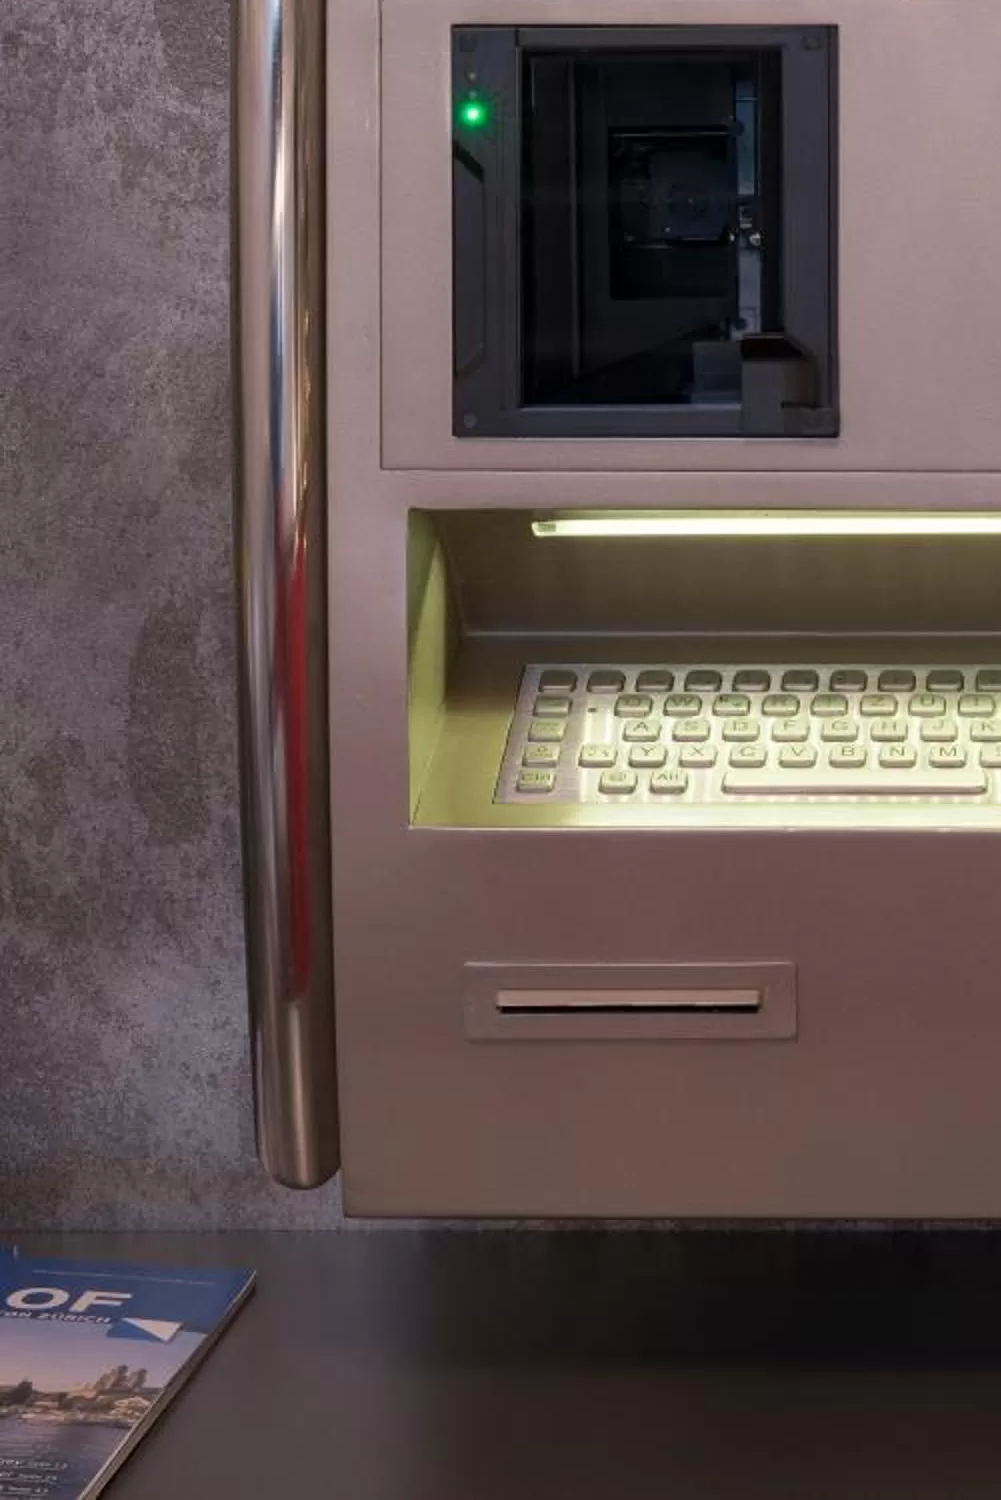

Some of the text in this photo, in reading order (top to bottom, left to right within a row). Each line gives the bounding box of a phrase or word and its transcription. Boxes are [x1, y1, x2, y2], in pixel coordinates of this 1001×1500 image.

[633, 721, 649, 731] A
[684, 721, 699, 732] S
[782, 721, 797, 731] F
[830, 721, 849, 732] G
[881, 721, 898, 731] H
[931, 721, 946, 731] J
[981, 721, 996, 732] K
[640, 746, 655, 757] Y
[689, 746, 704, 757] X
[739, 746, 755, 758] C
[790, 746, 805, 757] V
[841, 746, 856, 757] B
[889, 746, 906, 757] N
[938, 746, 958, 757] M
[6, 1286, 133, 1313] OF
